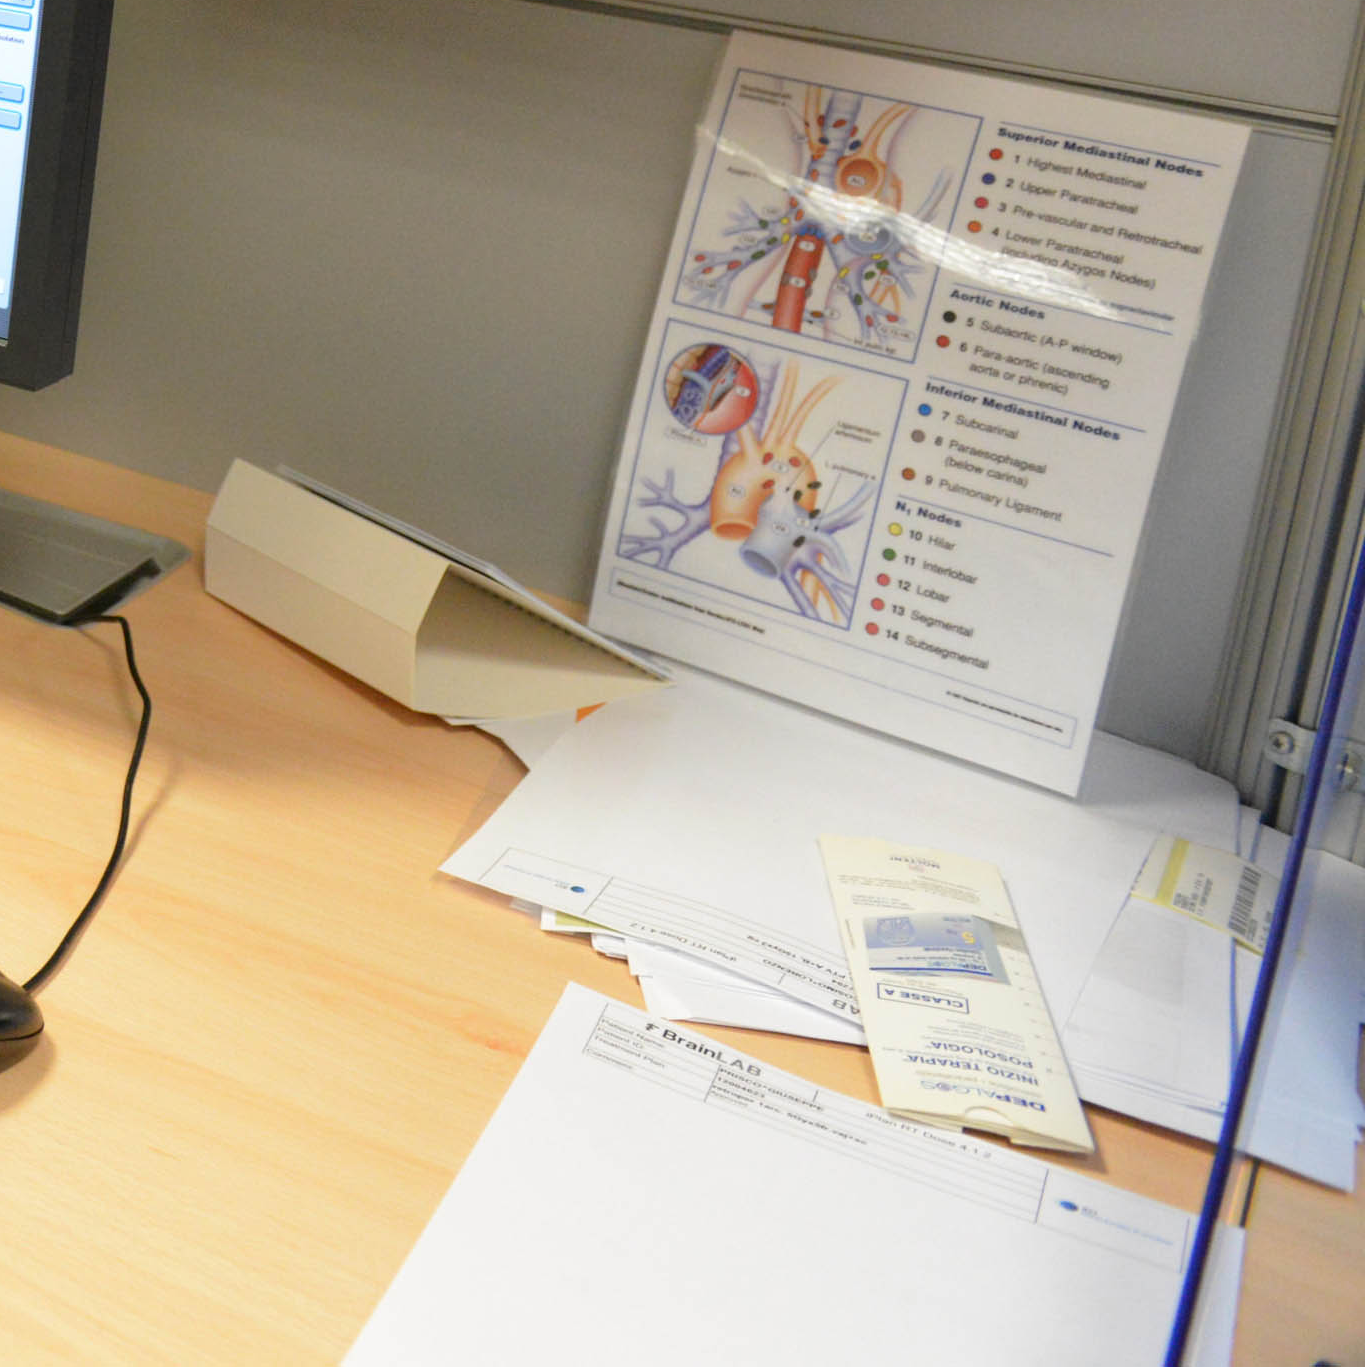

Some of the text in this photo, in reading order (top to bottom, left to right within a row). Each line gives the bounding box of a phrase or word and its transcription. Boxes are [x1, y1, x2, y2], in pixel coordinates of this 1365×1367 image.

[997, 127, 1204, 178] Superior Mediastinal Nodes
[1027, 157, 1073, 177] Highest
[1076, 167, 1147, 190] Mediastinal
[1005, 178, 1138, 215] 2 Upper Paratracheal
[997, 202, 1203, 255] 3 Pre-vascular and Retrotracheal
[991, 227, 1124, 265] 4 Lower Paratracheal
[1060, 259, 1106, 281] Azygos
[1110, 270, 1157, 291] Nodes)
[950, 288, 1046, 320] Aortic Nodes
[966, 317, 1123, 365] 5 Subaortic (A-P window)
[969, 362, 1069, 396] aorta or phrenic)
[973, 345, 1039, 371] Para-aortic
[1042, 362, 1110, 390] (ascending
[925, 382, 1121, 441] Inferior Mediastinal Nodes
[941, 411, 1019, 440] 7 Subcarinal
[934, 436, 1047, 475] 8 Paraesophageal
[944, 455, 1029, 489] (below carina)
[925, 475, 1063, 523] 9 Pulmonary Ligament
[917, 506, 962, 528] Nodes
[909, 529, 957, 551] 10 Hilar
[904, 554, 978, 585] 11 Interlobar
[898, 579, 950, 603] 12 Lobar
[892, 604, 974, 637] 13 Segmental
[886, 628, 990, 670] 14 Subsegmental
[884, 988, 964, 1009] CLASSE A
[662, 1029, 763, 1078] BrainLAB
[986, 1066, 1039, 1086] INIZIO
[920, 1079, 1047, 1113] DEPALGOS
